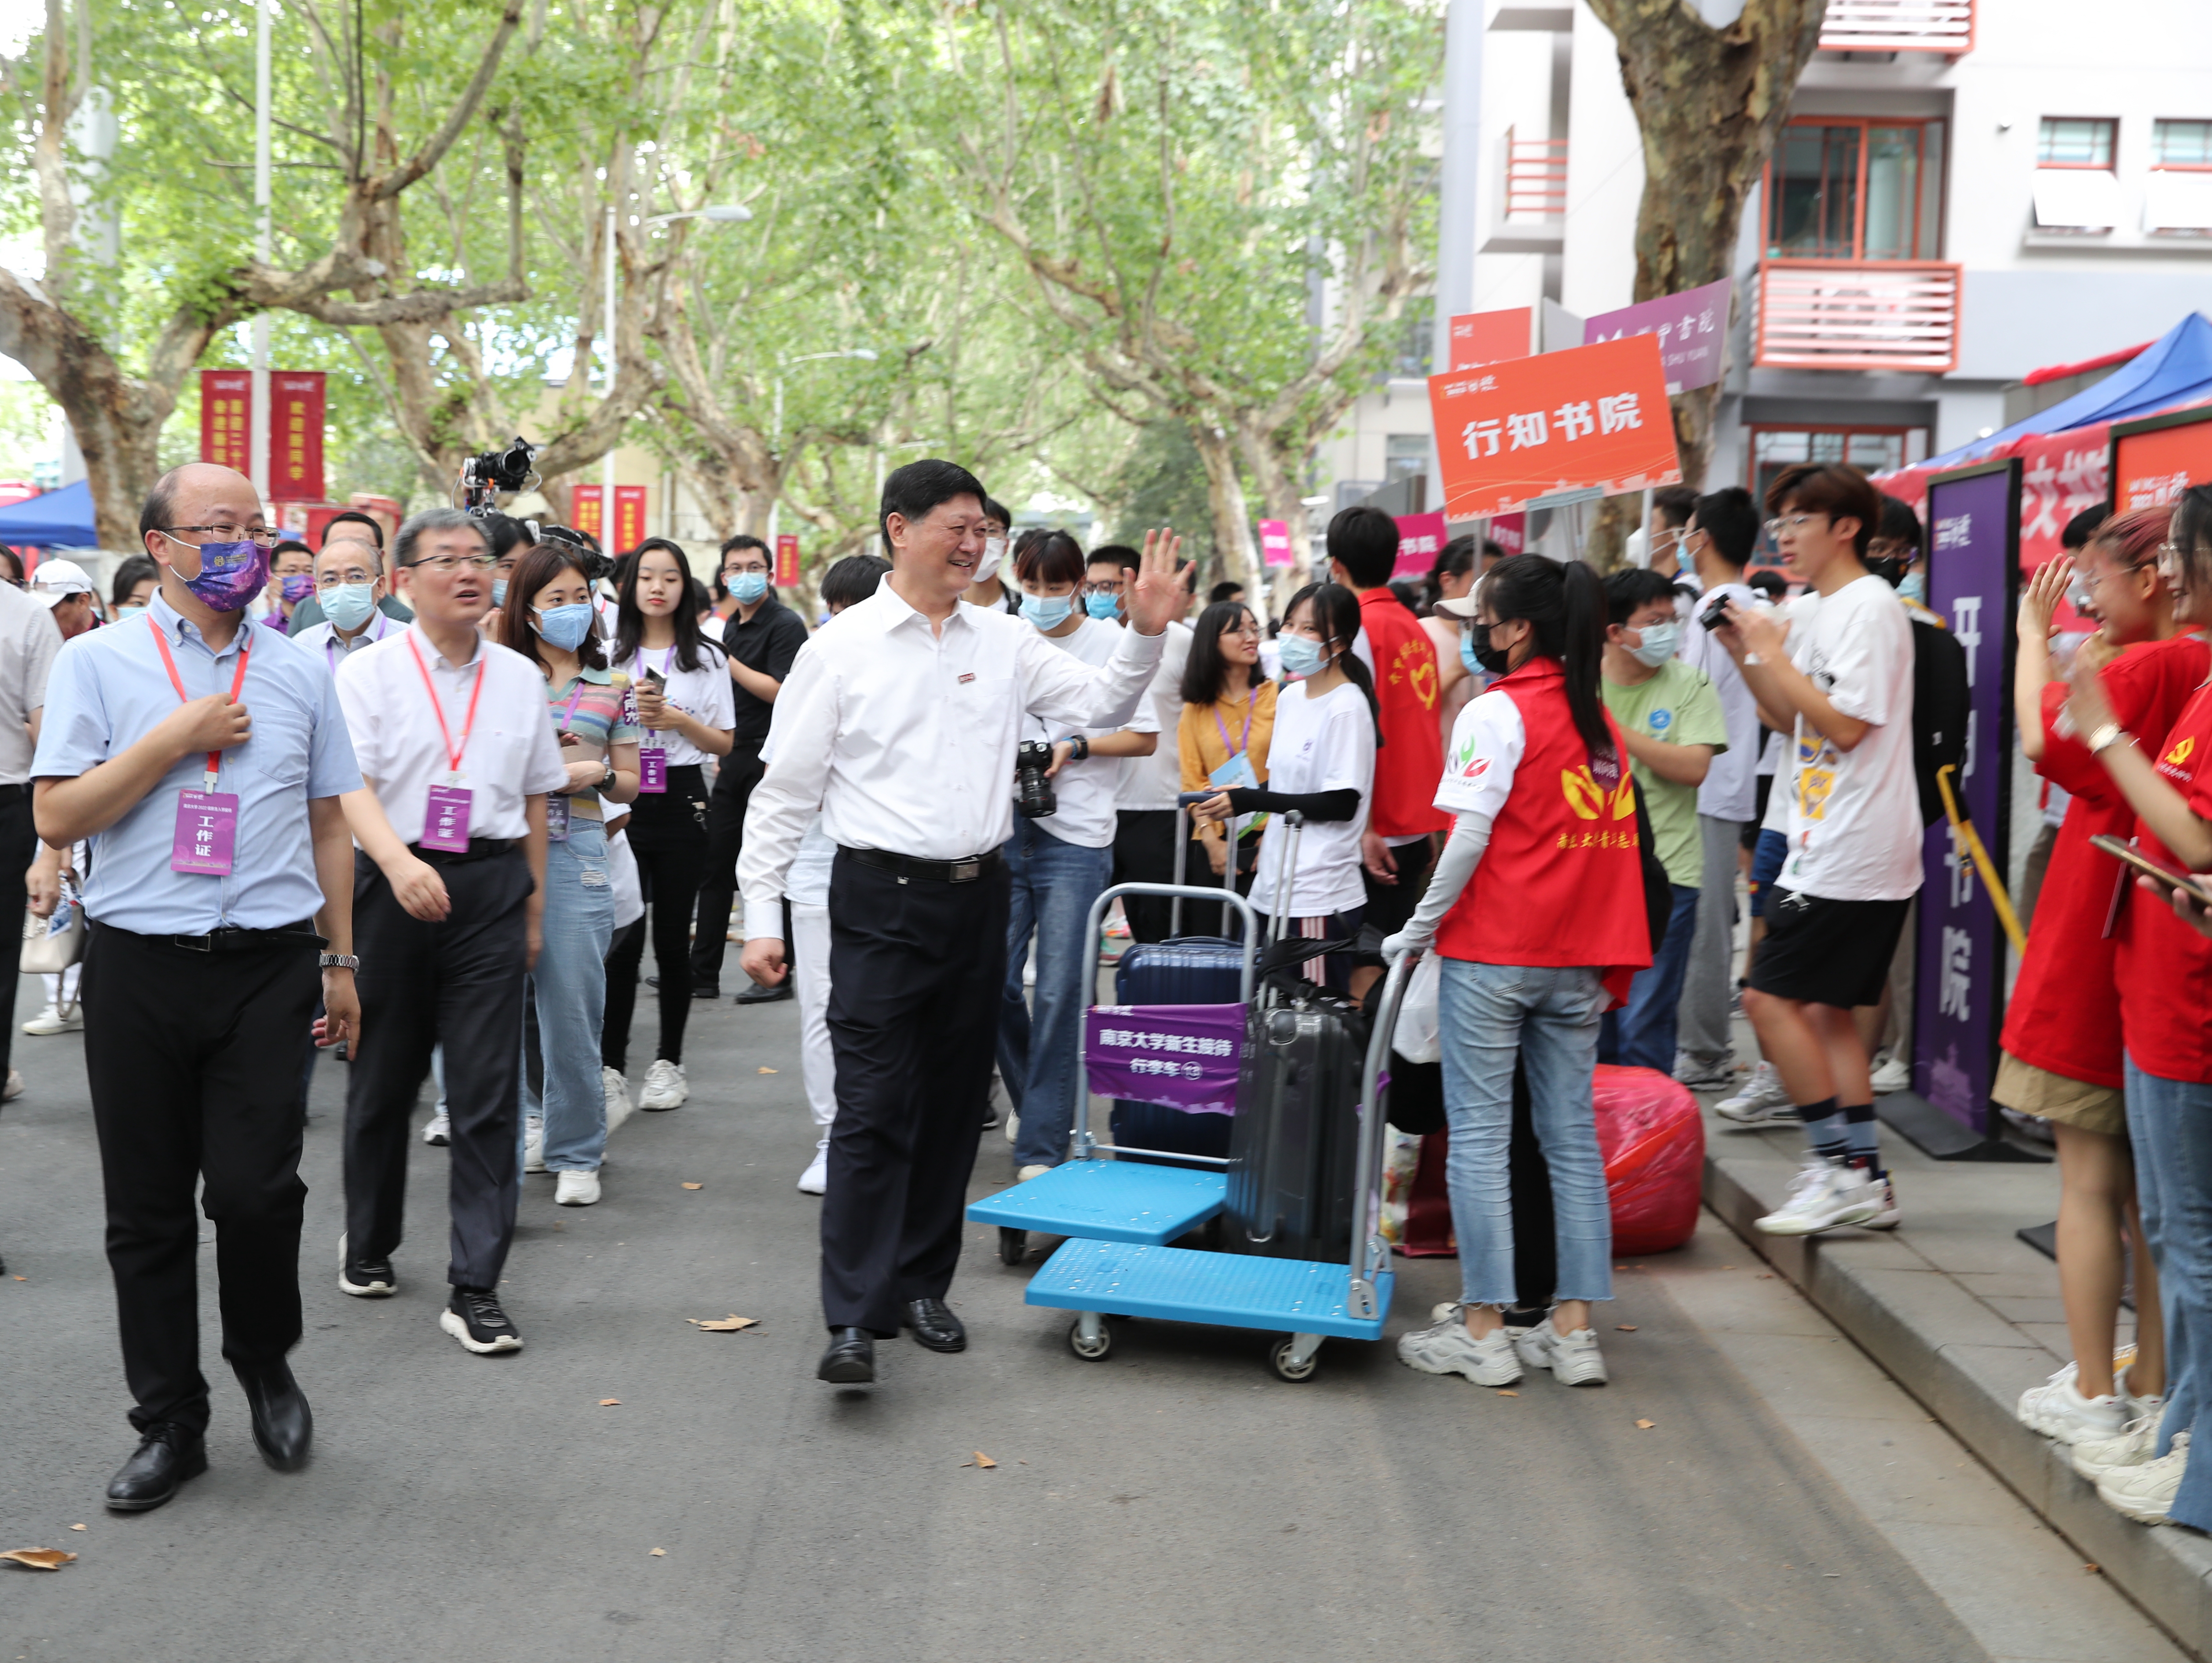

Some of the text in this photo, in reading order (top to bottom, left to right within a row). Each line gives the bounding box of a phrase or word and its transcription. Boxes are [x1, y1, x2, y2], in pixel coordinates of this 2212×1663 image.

[1462, 392, 1643, 460] 行知书院
[1396, 535, 1438, 556] 书院
[1940, 596, 1982, 1022] 开书院
[195, 816, 214, 857] 工作证
[1099, 1028, 1233, 1056] 南京大学新生接待
